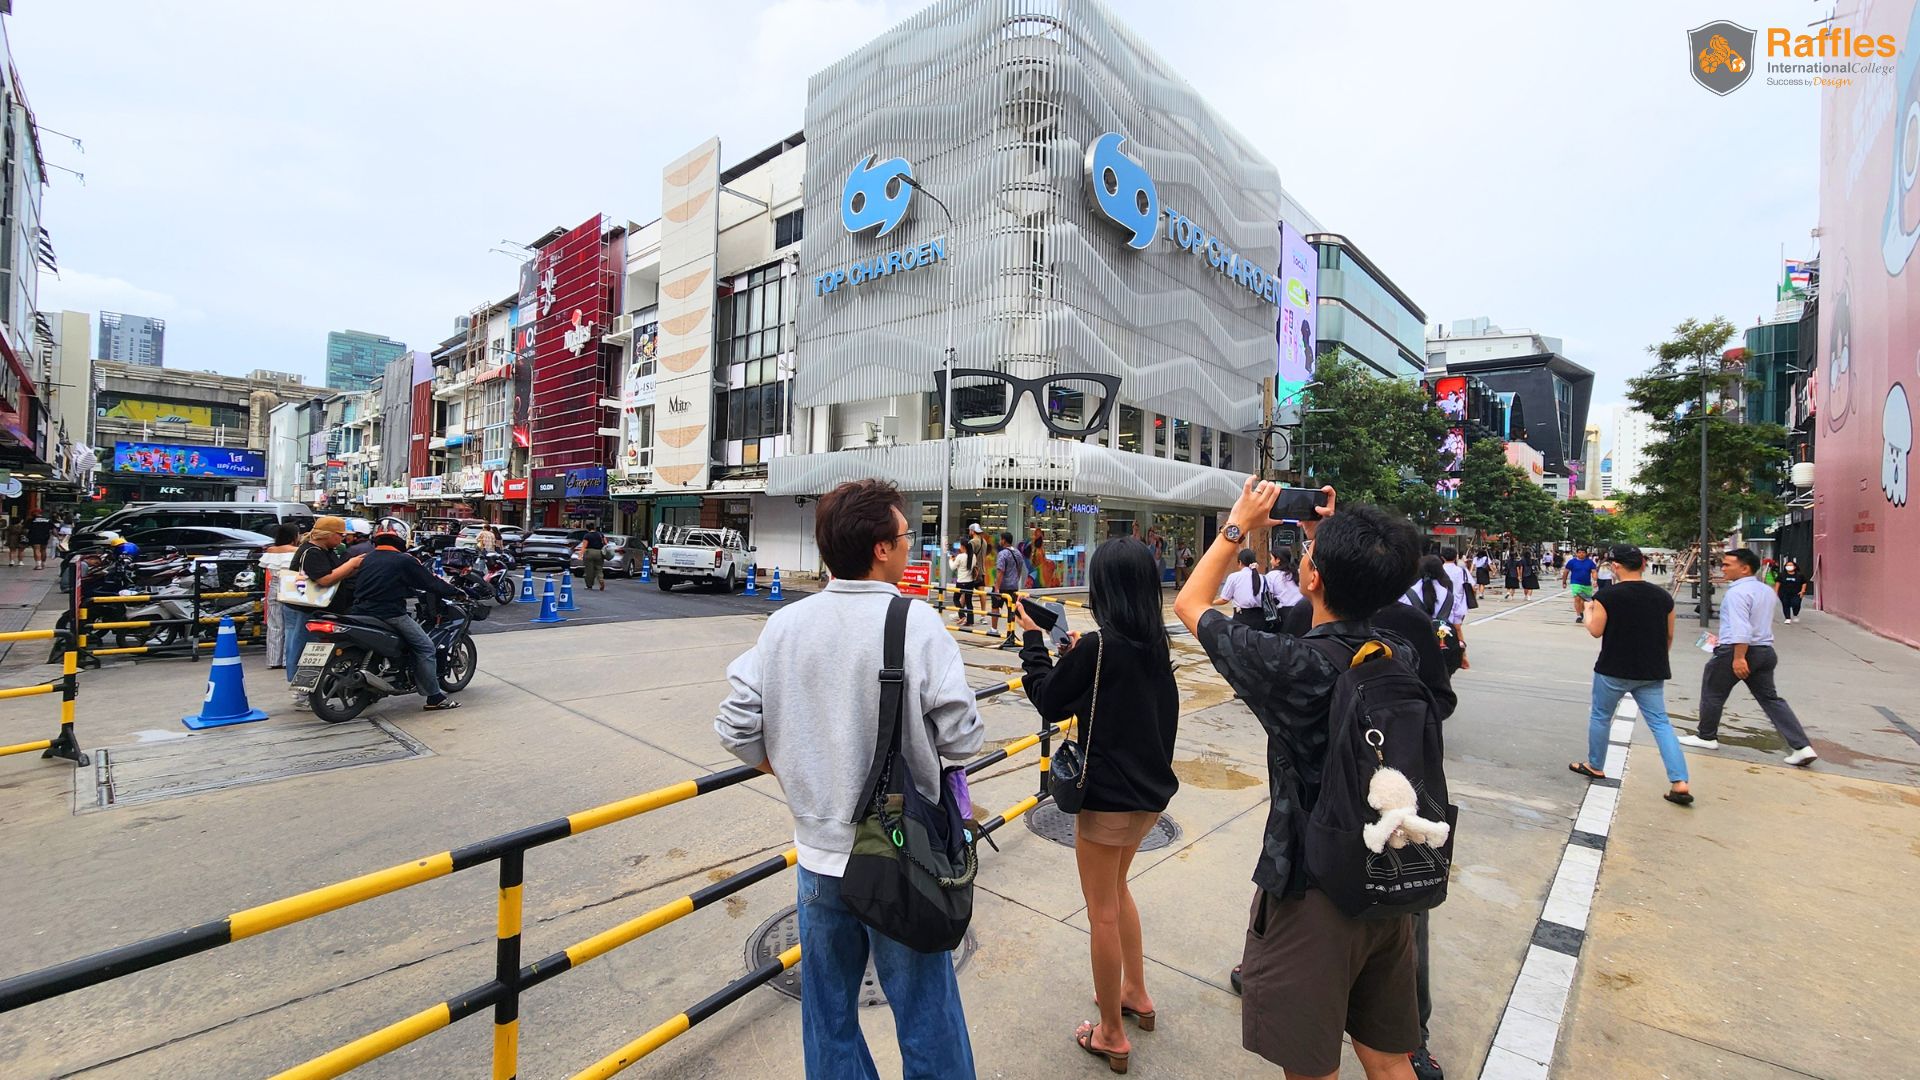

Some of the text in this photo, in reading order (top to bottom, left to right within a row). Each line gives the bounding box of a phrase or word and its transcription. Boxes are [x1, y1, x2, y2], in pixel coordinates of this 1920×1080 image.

[815, 235, 945, 297] TOP CHAROEN
[1163, 206, 1281, 308] TOP CHAROEN
[1067, 503, 1099, 514] CHAROEN
